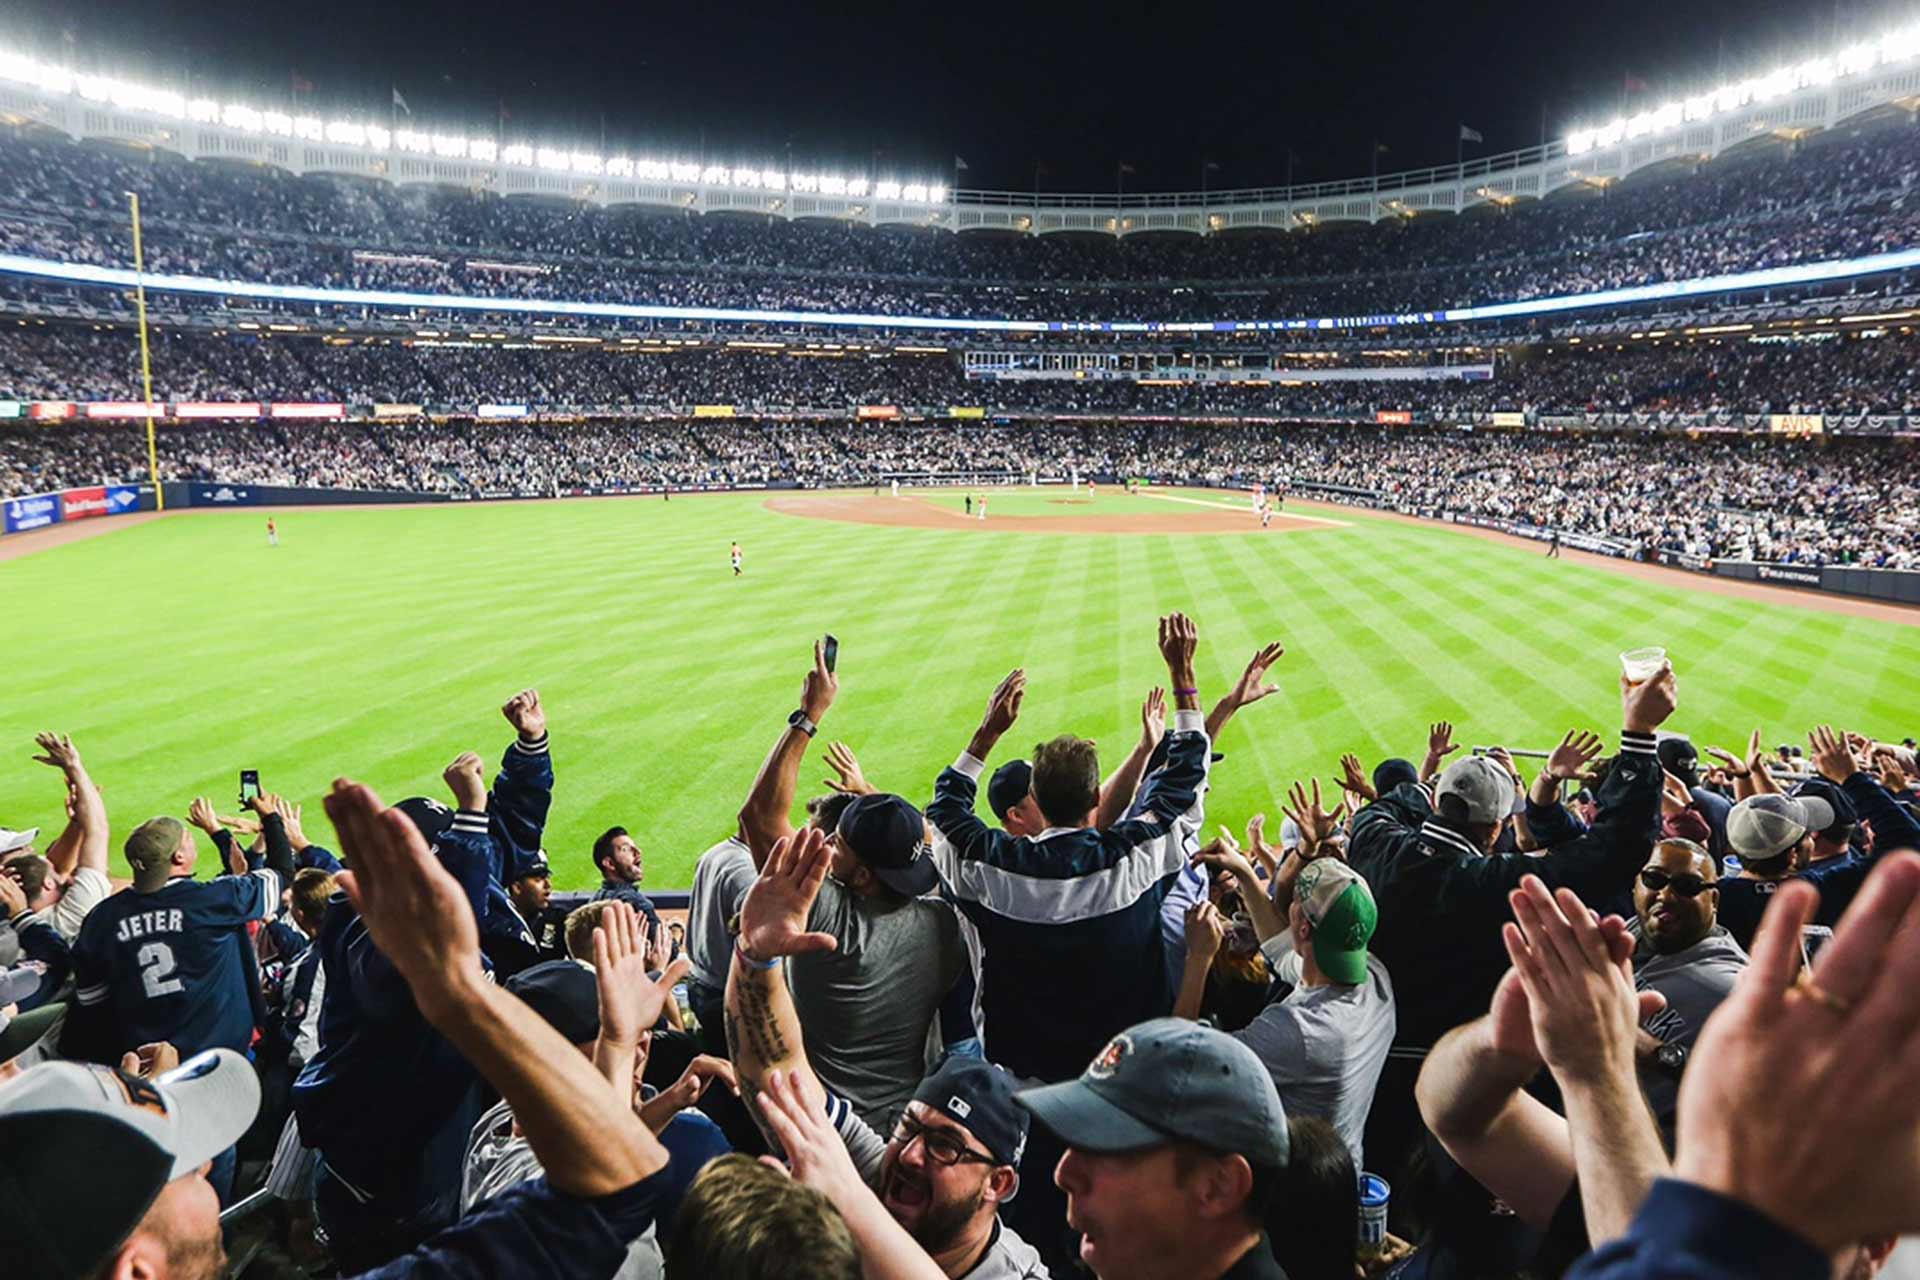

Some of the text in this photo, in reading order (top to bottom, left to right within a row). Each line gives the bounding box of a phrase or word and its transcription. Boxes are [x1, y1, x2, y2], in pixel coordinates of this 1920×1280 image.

[1781, 416, 1813, 433] AVIS
[117, 908, 183, 941] JETER
[137, 942, 182, 998] 2
